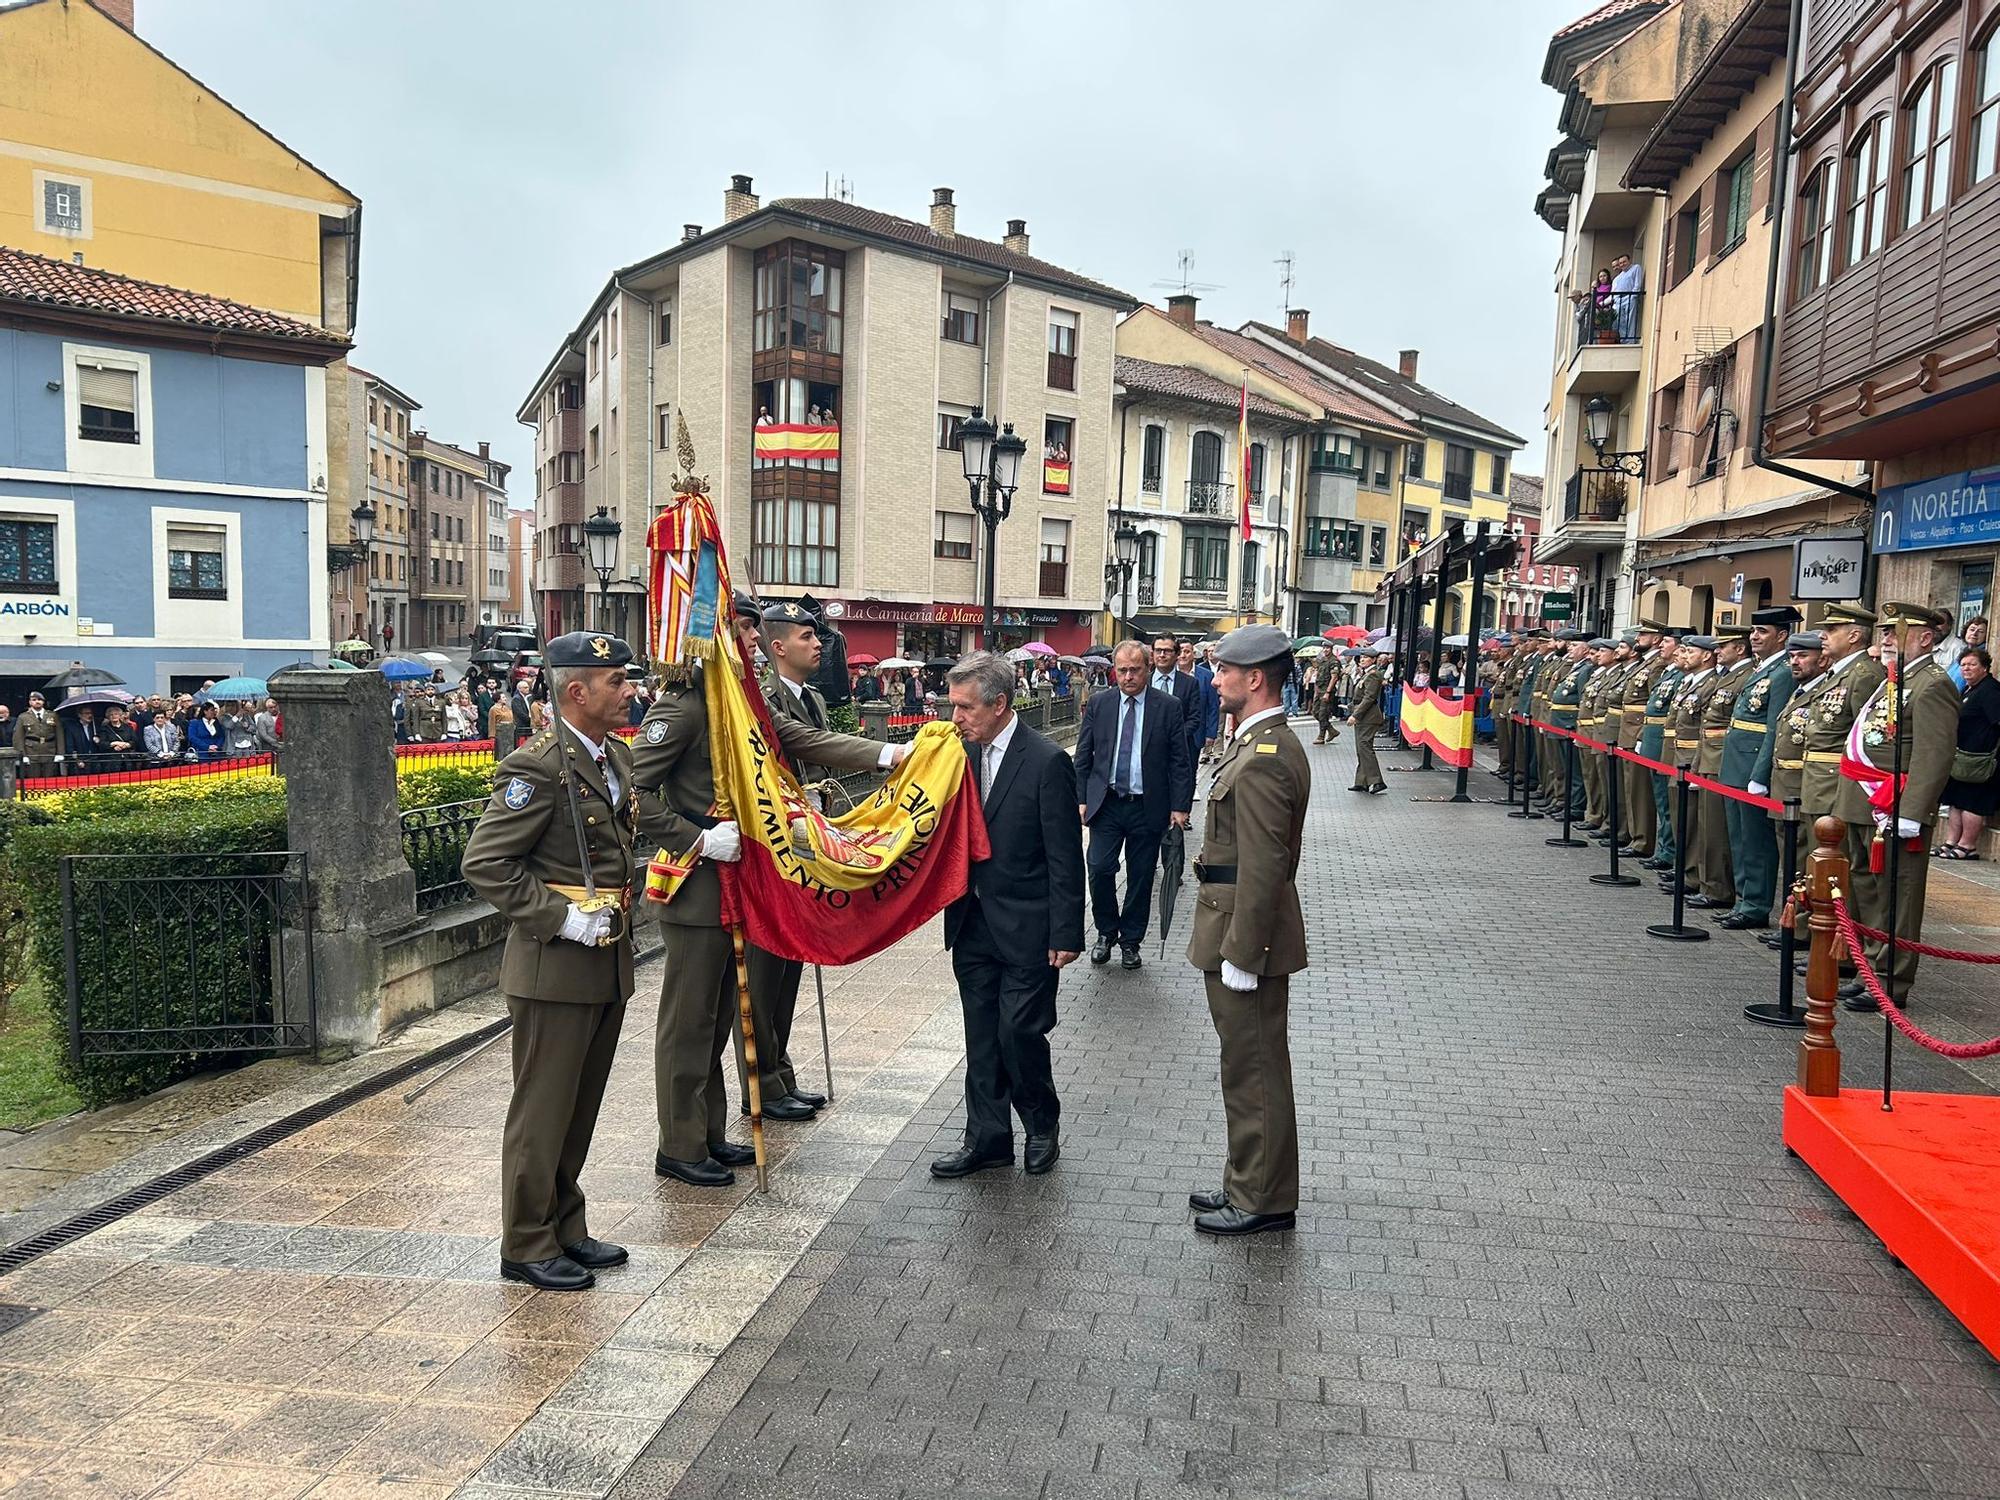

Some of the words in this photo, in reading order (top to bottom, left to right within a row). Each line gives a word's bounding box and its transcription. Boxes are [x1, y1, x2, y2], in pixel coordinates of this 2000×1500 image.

[1803, 561, 1857, 578] HATCHET
[0, 600, 69, 616] ARBÓN
[847, 605, 863, 618] La
[866, 605, 932, 621] Carnicería
[936, 607, 948, 621] de
